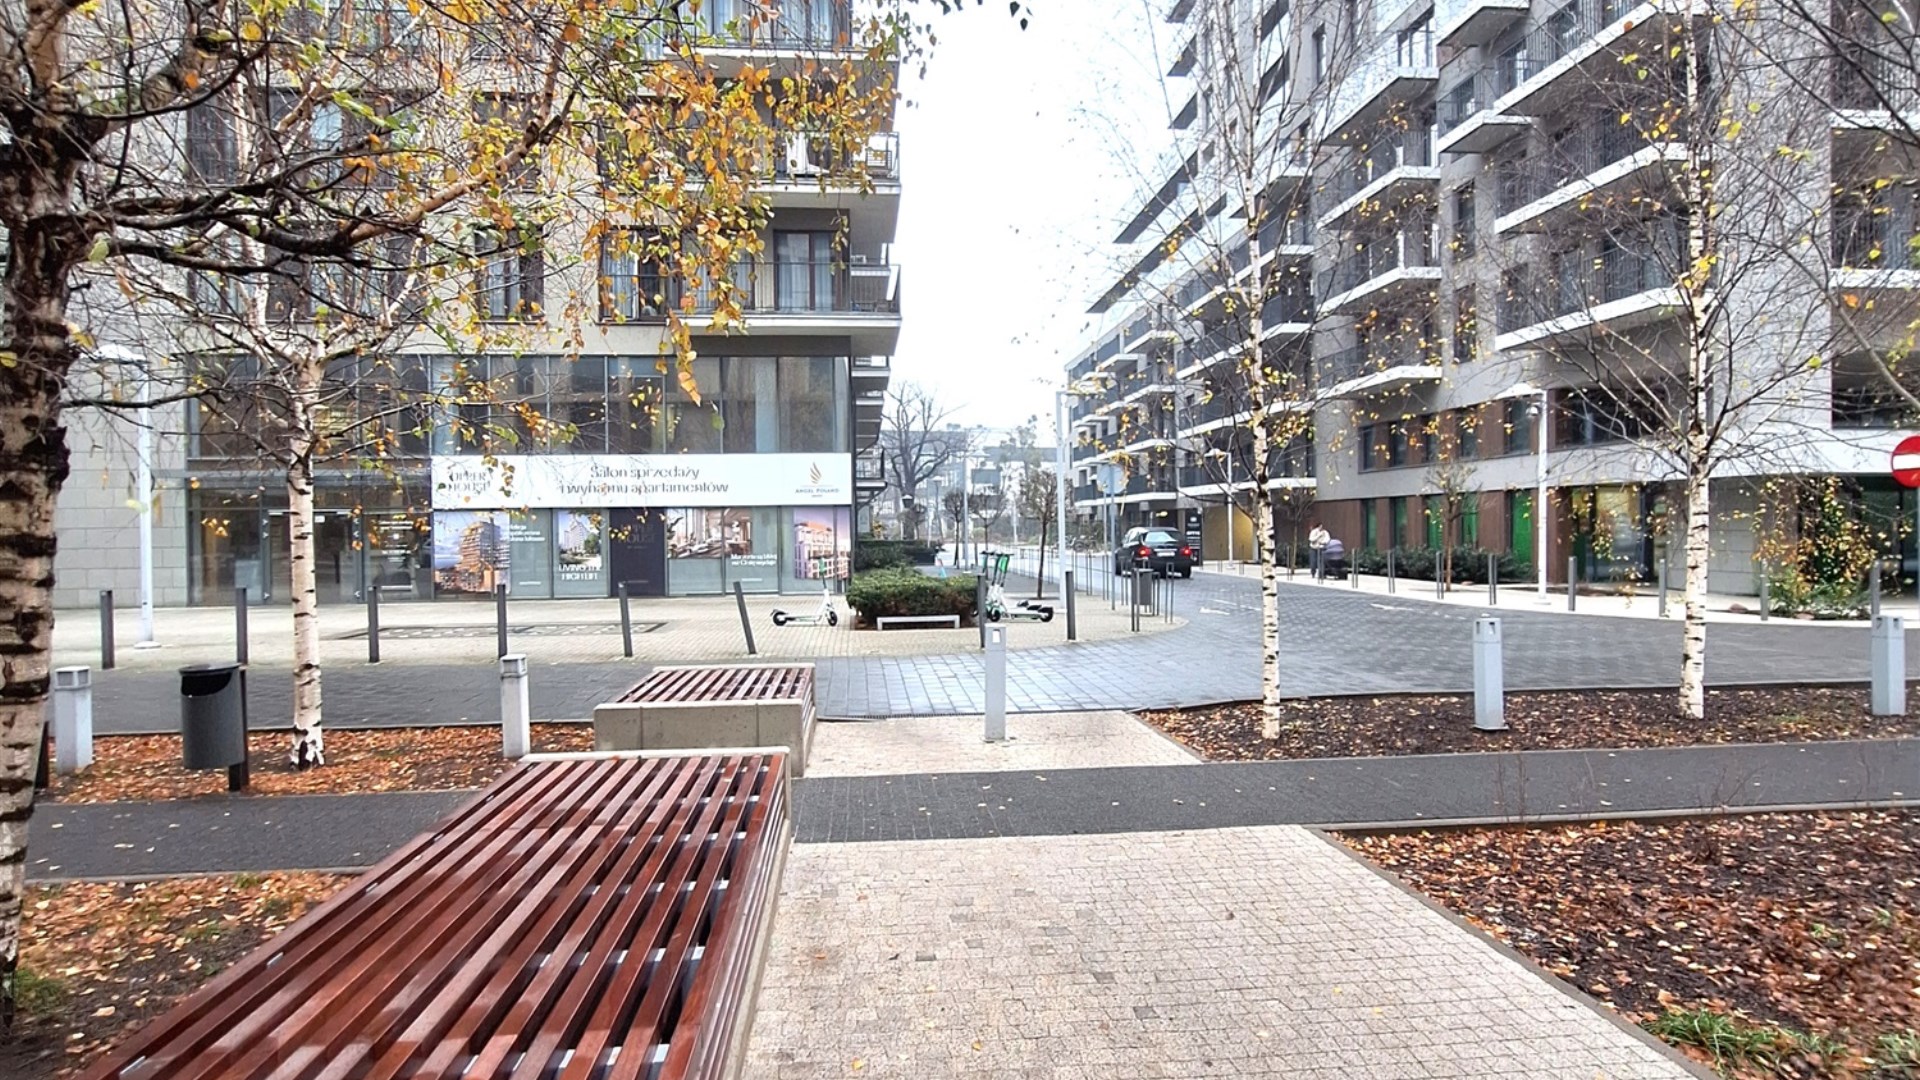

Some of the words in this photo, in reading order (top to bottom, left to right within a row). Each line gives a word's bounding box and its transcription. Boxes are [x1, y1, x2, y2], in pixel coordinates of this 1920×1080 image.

[590, 465, 627, 478] Salon
[630, 465, 700, 480] sprzedaży
[567, 481, 628, 496] wynamu
[630, 481, 729, 495] apartamentów
